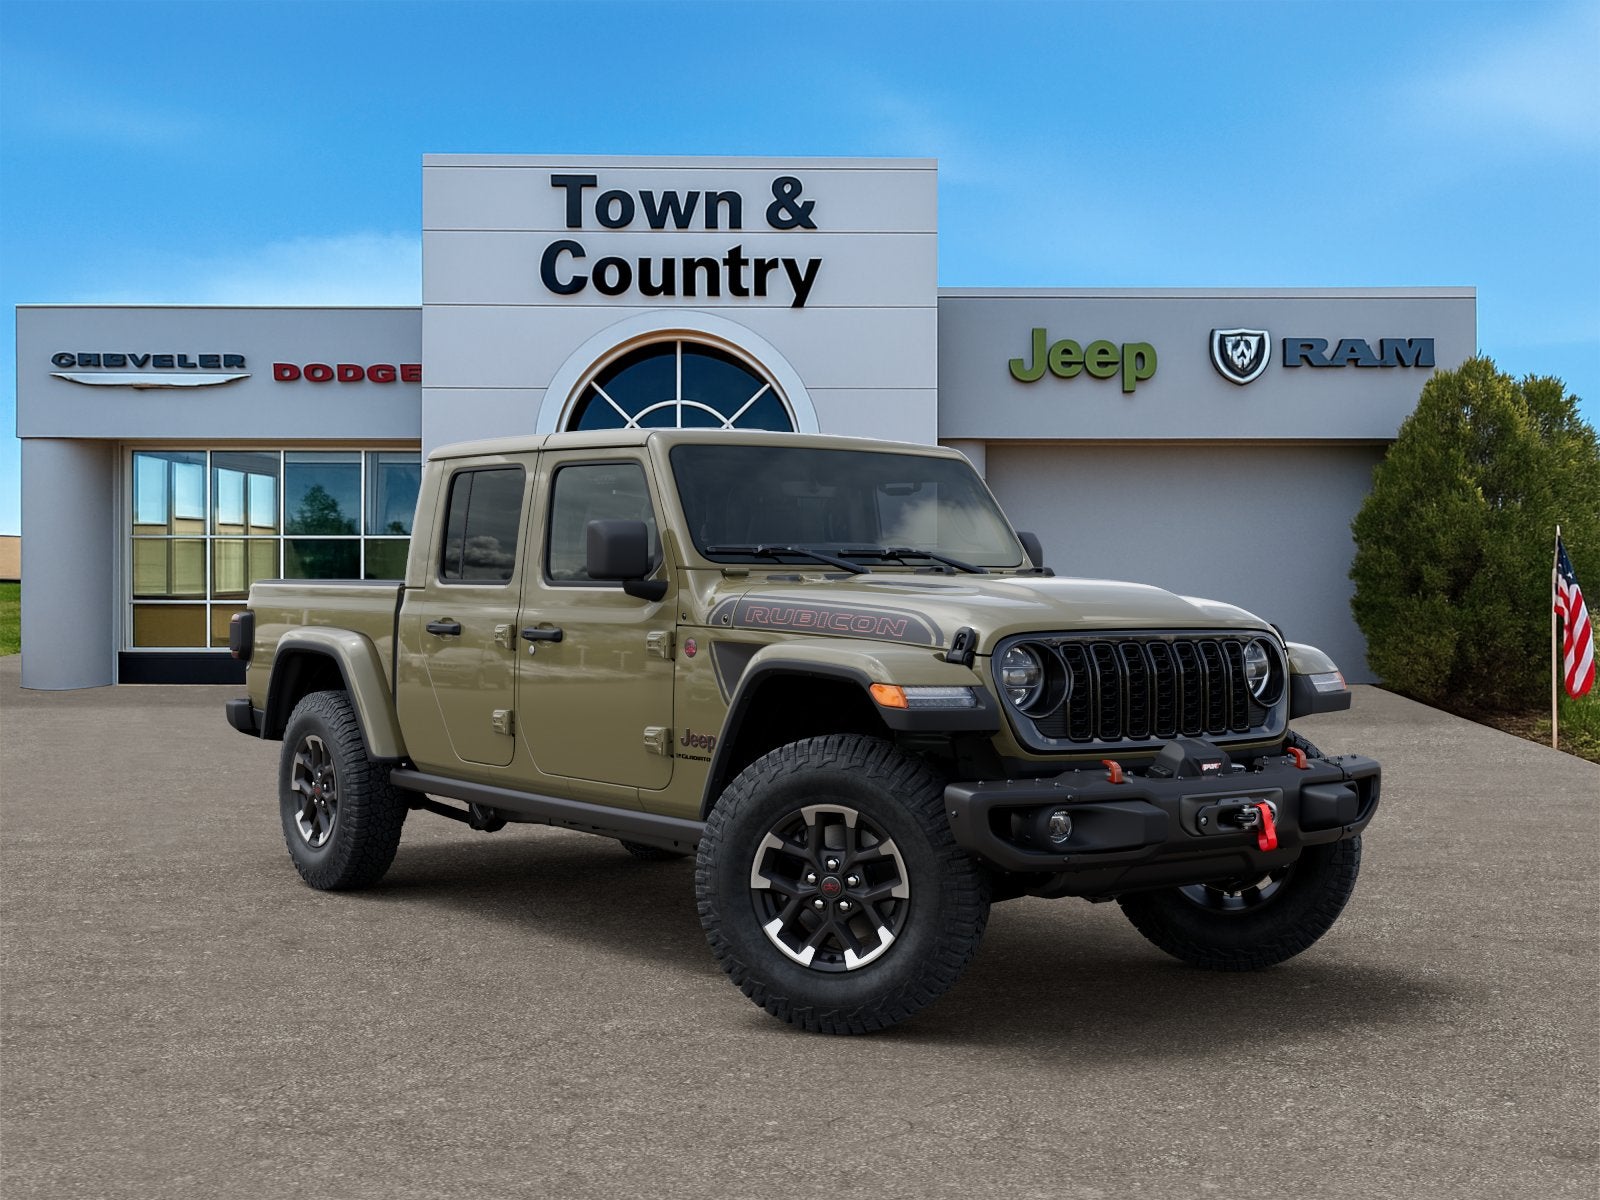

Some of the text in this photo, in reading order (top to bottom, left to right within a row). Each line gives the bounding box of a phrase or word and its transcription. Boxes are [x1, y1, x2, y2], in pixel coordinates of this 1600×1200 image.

[550, 174, 818, 230] Town &
[539, 239, 823, 308] Country
[1009, 327, 1158, 393] Jeep
[1283, 337, 1436, 368] RAM
[272, 362, 422, 383] DODGE
[745, 606, 908, 637] RUBICON
[680, 727, 717, 754] Jeep
[681, 753, 712, 763] GLADIATO
